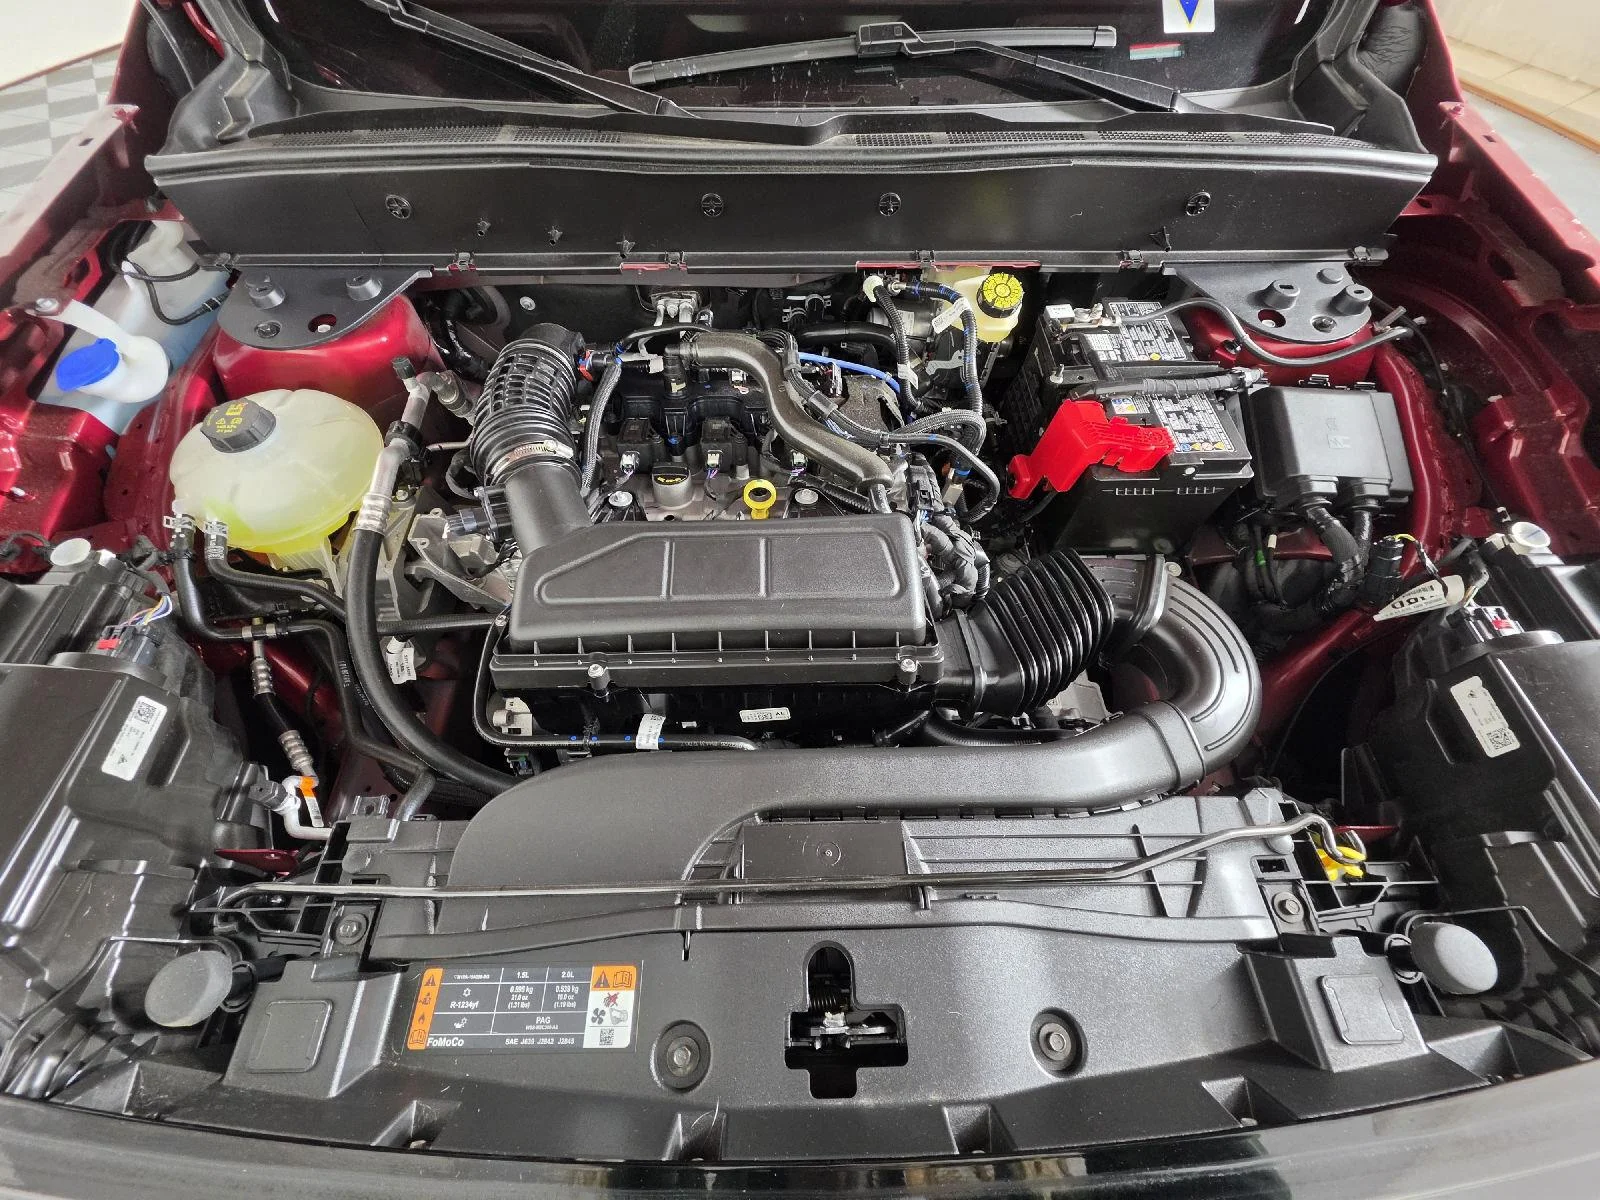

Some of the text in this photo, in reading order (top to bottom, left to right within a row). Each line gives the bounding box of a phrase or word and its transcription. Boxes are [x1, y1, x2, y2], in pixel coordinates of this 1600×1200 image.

[517, 971, 530, 979] 1.5L
[561, 971, 575, 979] 2.0L
[526, 986, 534, 994] kg
[571, 986, 579, 994] kg
[449, 1000, 480, 1010] R-1234yf
[535, 1016, 551, 1024] PAG
[426, 1036, 465, 1047] FoMoCo
